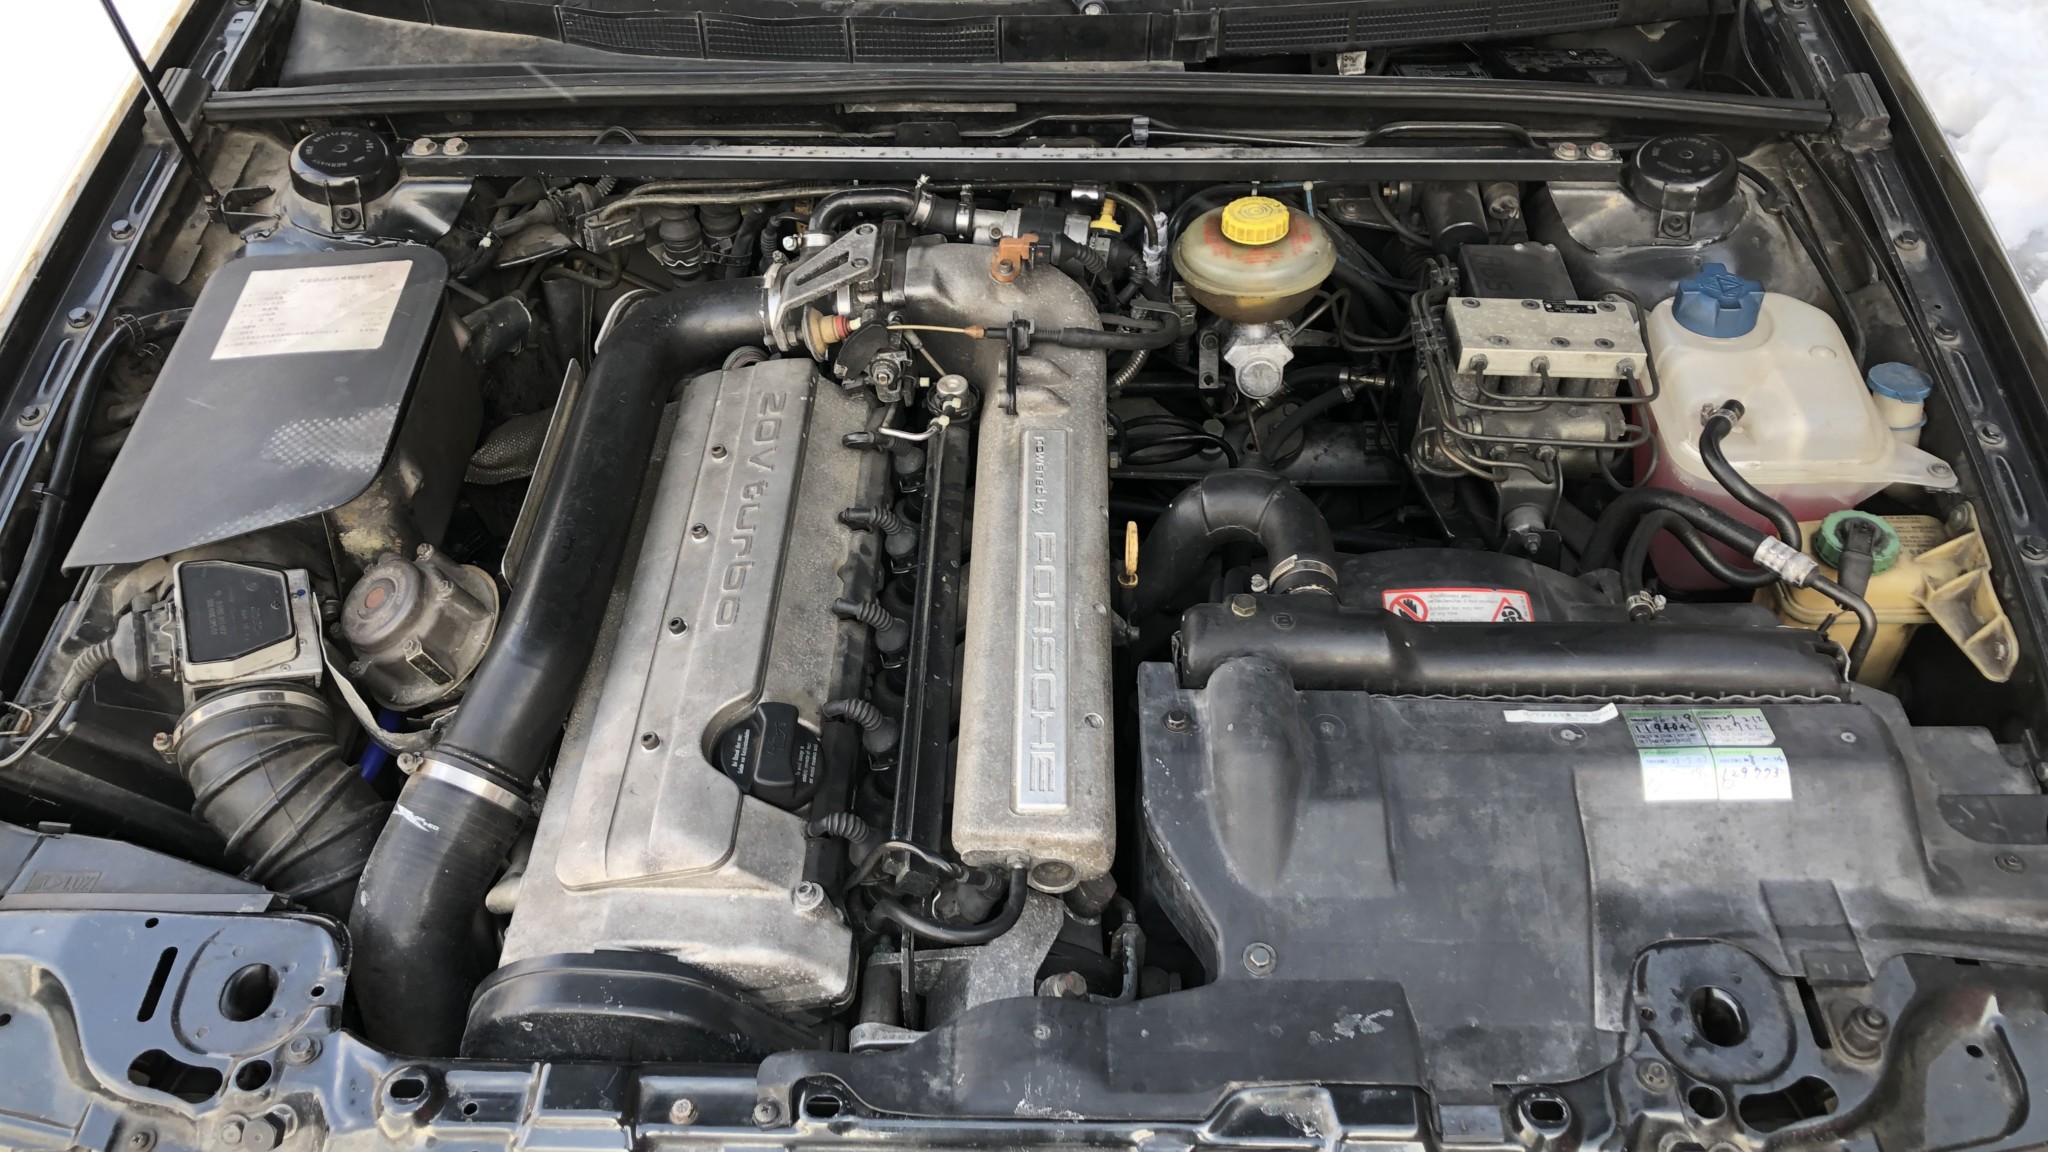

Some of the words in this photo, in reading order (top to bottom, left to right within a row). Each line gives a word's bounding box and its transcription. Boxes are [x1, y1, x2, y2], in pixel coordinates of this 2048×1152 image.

[1475, 255, 1514, 291] ABS
[747, 391, 787, 471] 20V
[1033, 435, 1047, 495] powered
[1031, 498, 1046, 515] by
[713, 479, 769, 629] turbo
[1029, 531, 1056, 792] PORSCHE
